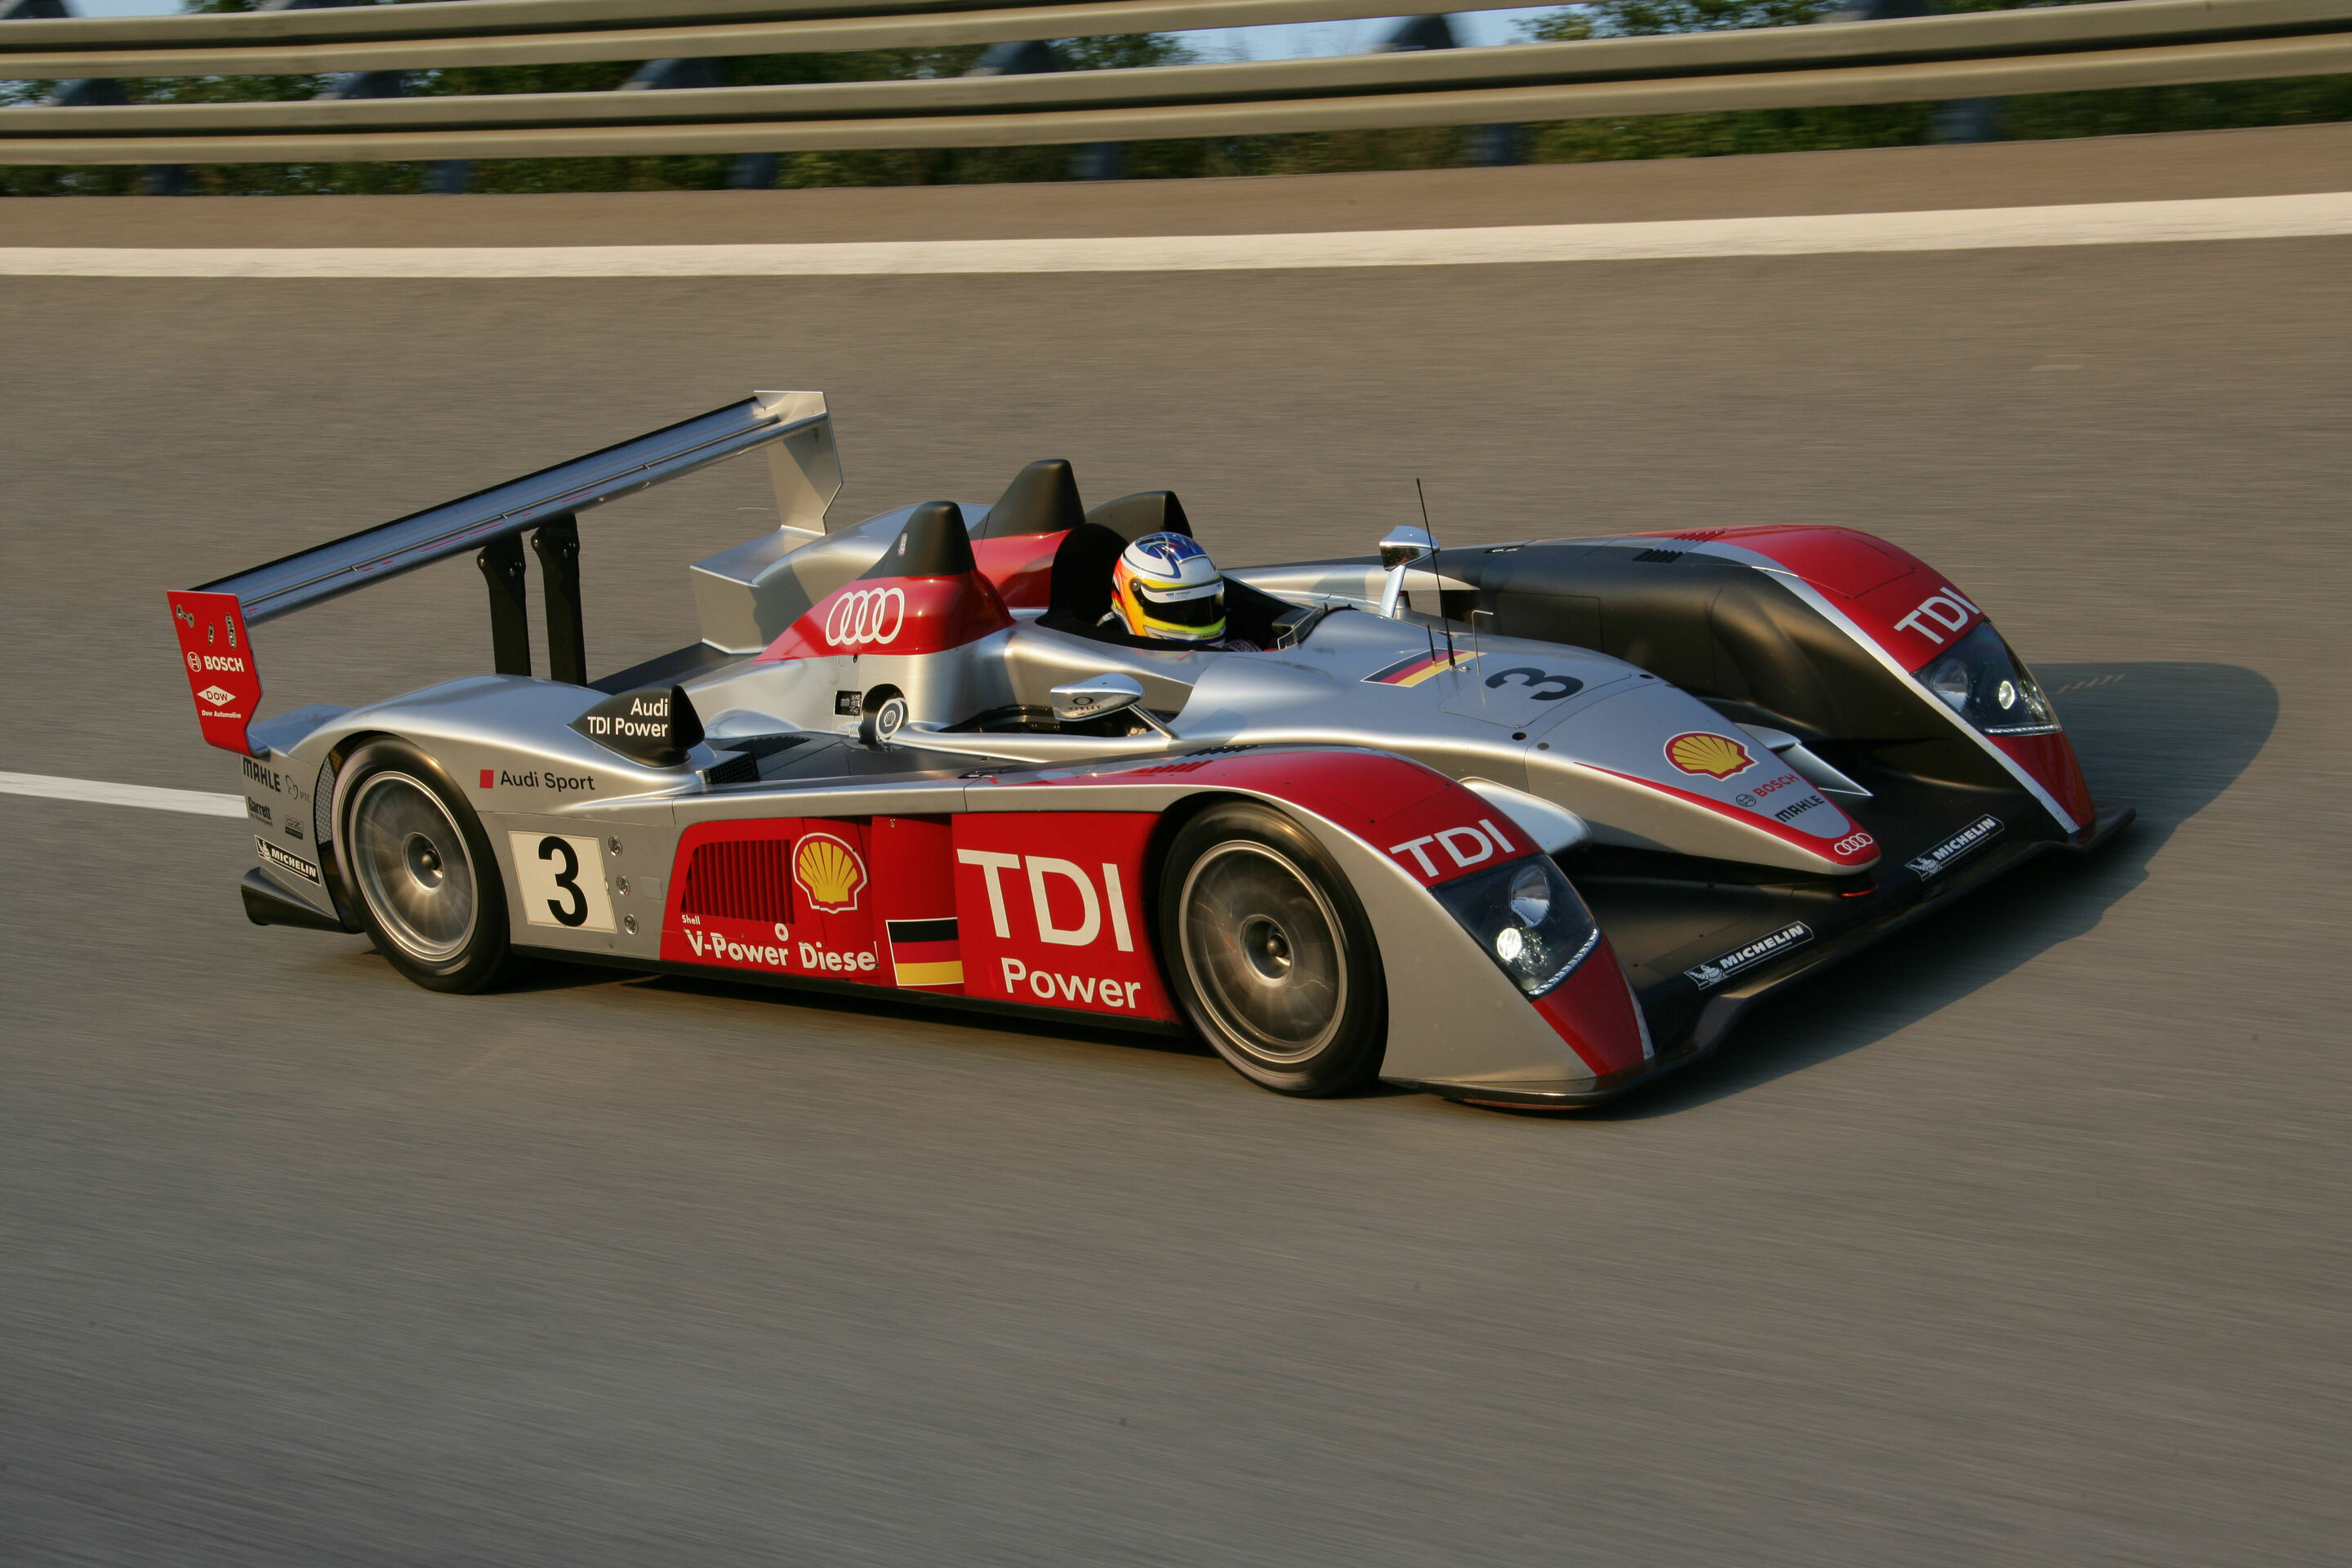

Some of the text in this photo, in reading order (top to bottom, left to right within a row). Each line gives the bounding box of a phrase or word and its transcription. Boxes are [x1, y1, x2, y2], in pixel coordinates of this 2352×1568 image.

[1893, 586, 1980, 644] TDI
[203, 655, 245, 672] BOSCH
[1485, 667, 1584, 701] 3
[214, 710, 241, 719] Automotive
[630, 697, 669, 717] Audi
[587, 715, 668, 737] TDI Power
[243, 756, 282, 793] MAHLE
[500, 770, 595, 793] Audi Sport
[1753, 773, 1799, 798] BOSCH
[1775, 795, 1824, 823] MAHLE
[1389, 818, 1515, 878] TDI
[1932, 817, 1997, 861] MICHELIN
[271, 848, 317, 878] MICHELIN
[538, 835, 588, 927] 3
[956, 849, 1134, 952] TDI
[682, 915, 701, 925] Shell
[684, 929, 790, 966] V-Power
[1719, 925, 1805, 969] MICHELIN
[1000, 957, 1141, 1009] Power
